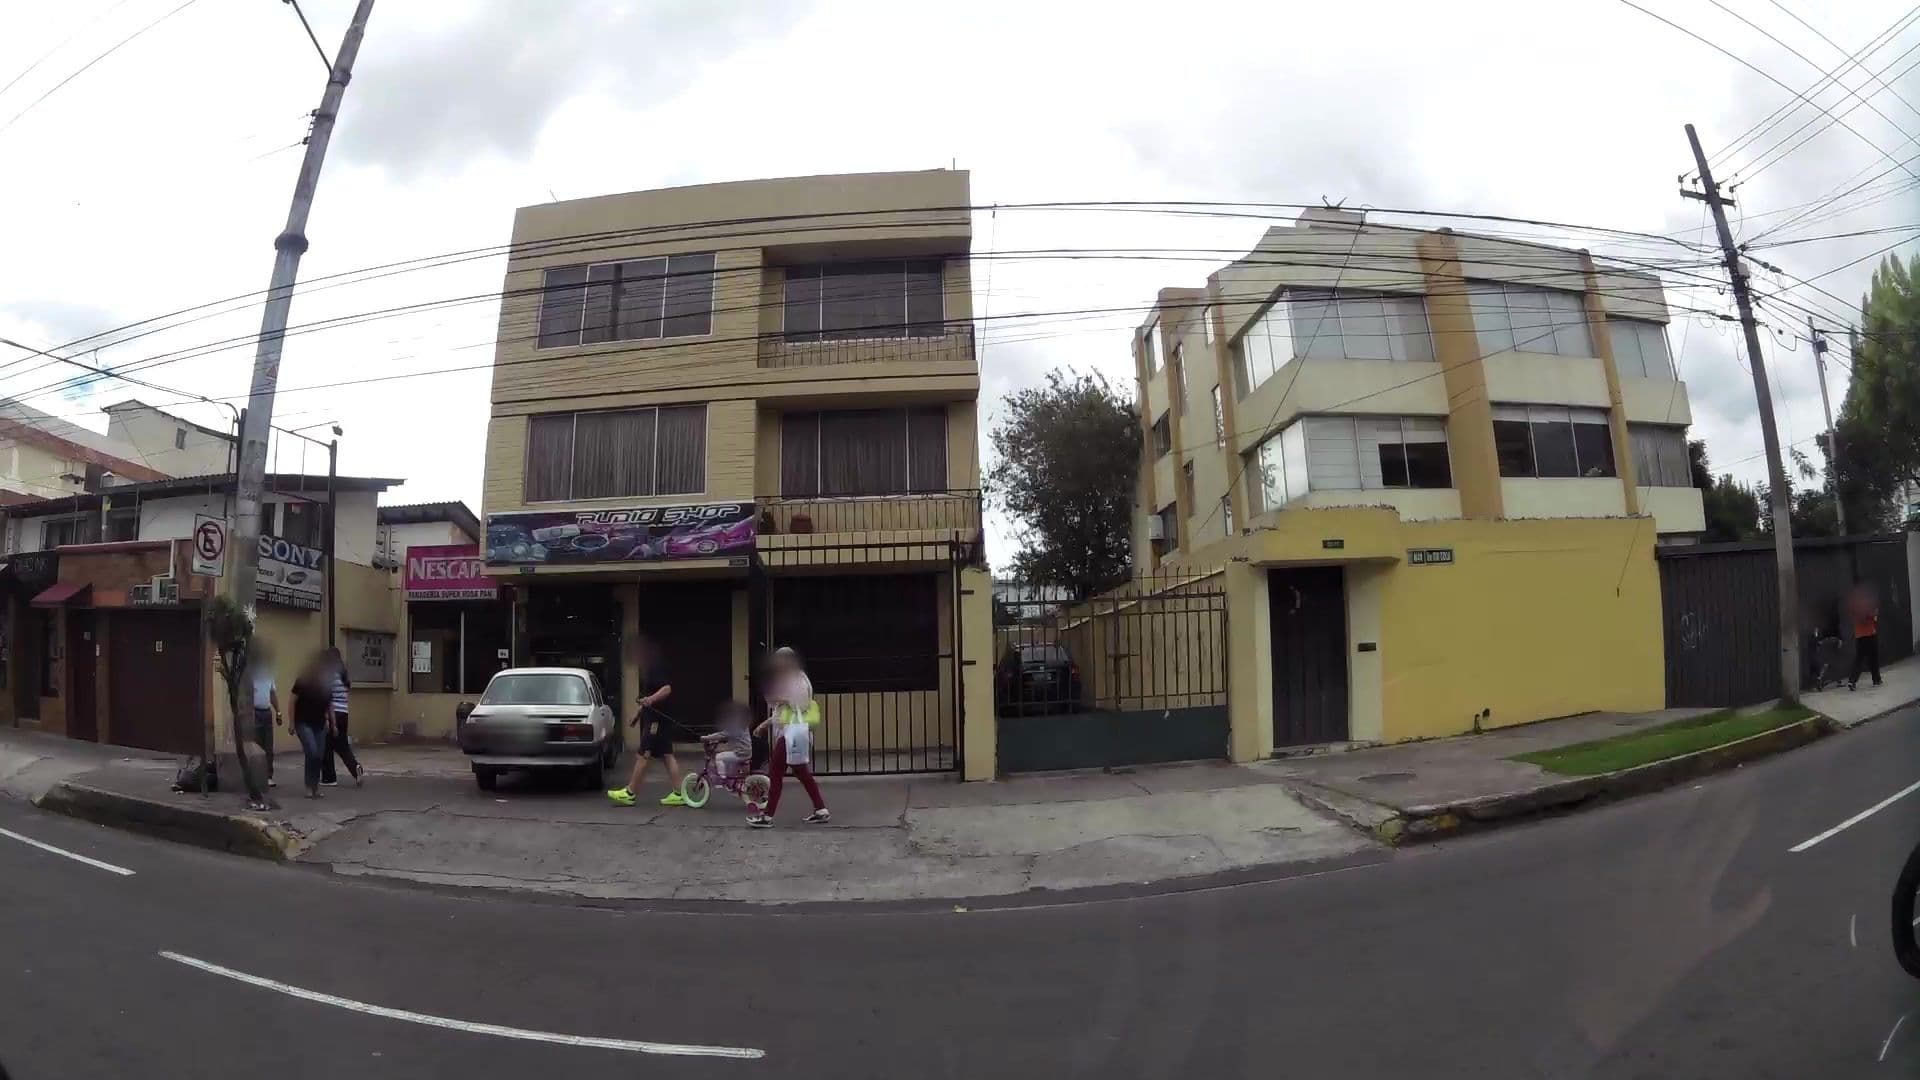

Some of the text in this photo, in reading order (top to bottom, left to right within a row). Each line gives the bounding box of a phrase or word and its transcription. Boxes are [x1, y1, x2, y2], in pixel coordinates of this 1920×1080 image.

[664, 504, 741, 522] SHOP
[257, 534, 322, 568] SONY
[409, 556, 489, 580] NESCAF
